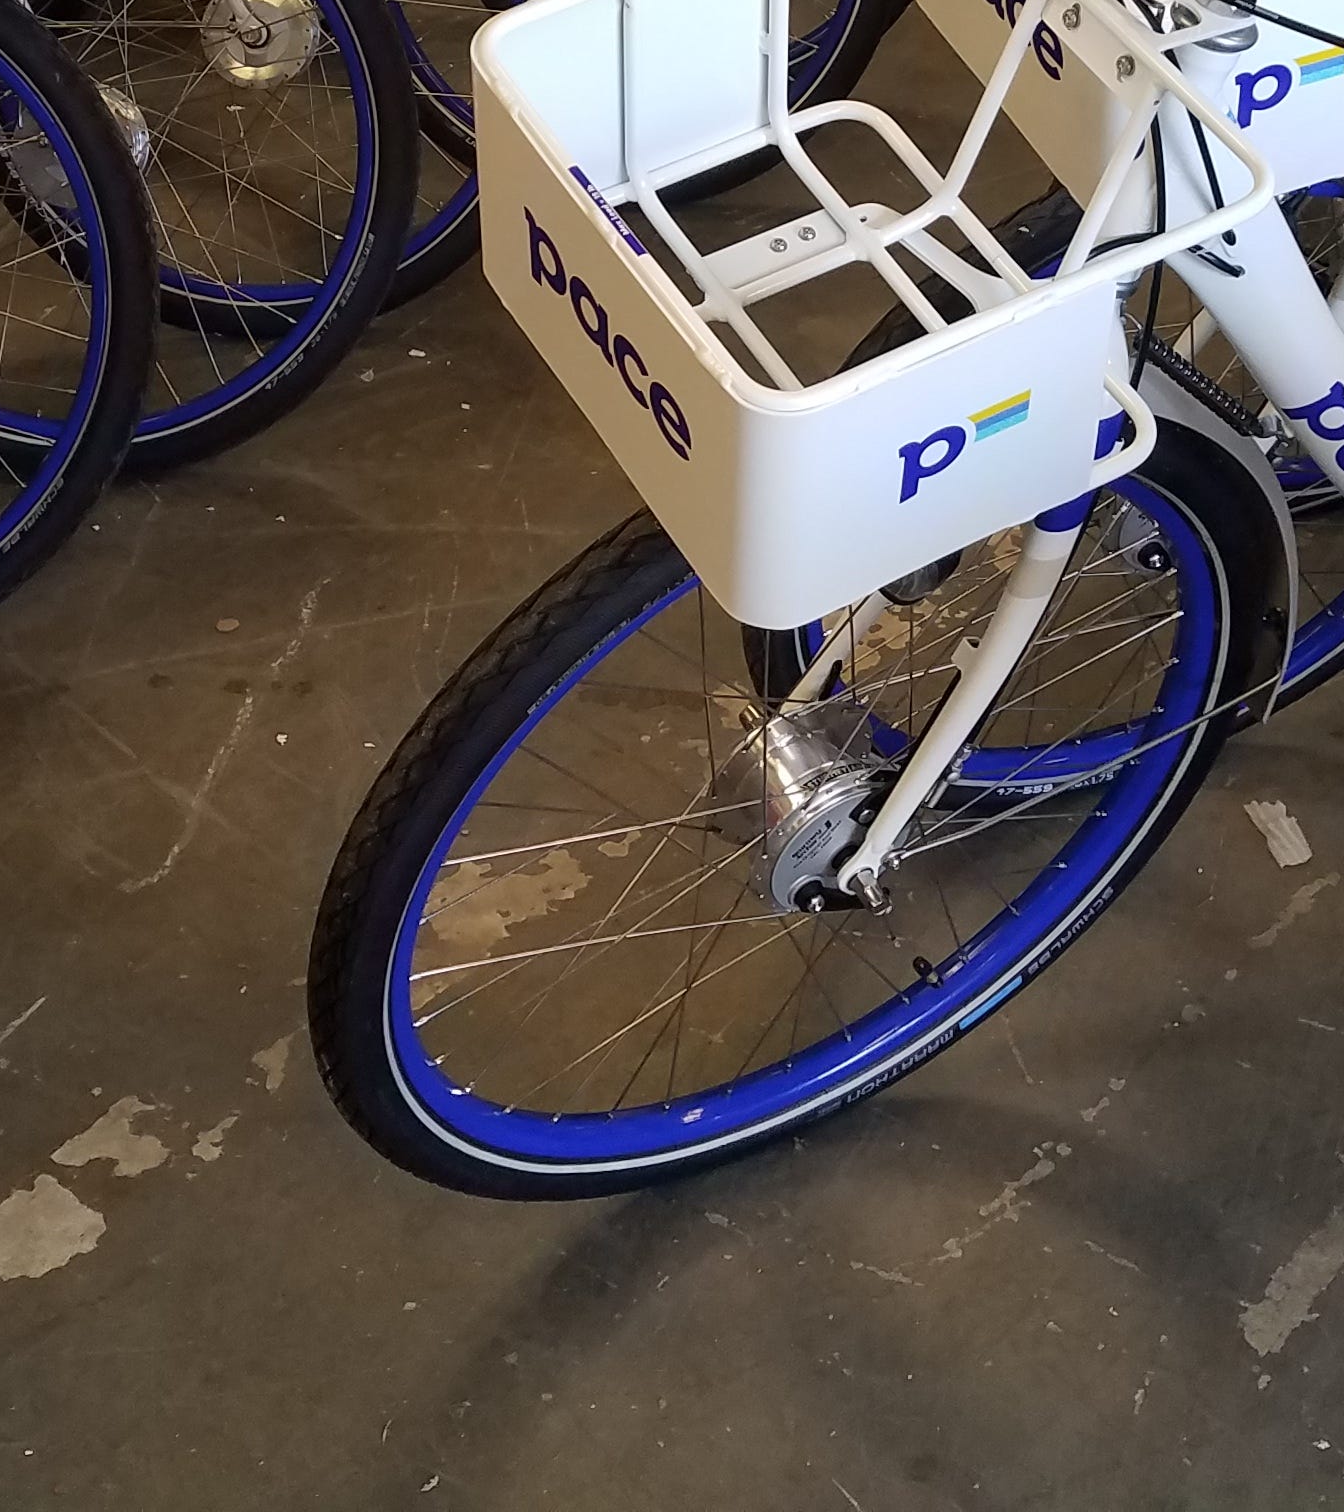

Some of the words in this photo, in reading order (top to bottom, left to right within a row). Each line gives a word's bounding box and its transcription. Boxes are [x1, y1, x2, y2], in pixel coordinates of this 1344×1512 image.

[1234, 64, 1294, 129] p
[524, 205, 693, 462] pace
[897, 425, 966, 504] p
[996, 783, 1054, 796] 47-559
[1027, 886, 1115, 975] SCHWALBE
[846, 1029, 956, 1106] MARATHON
